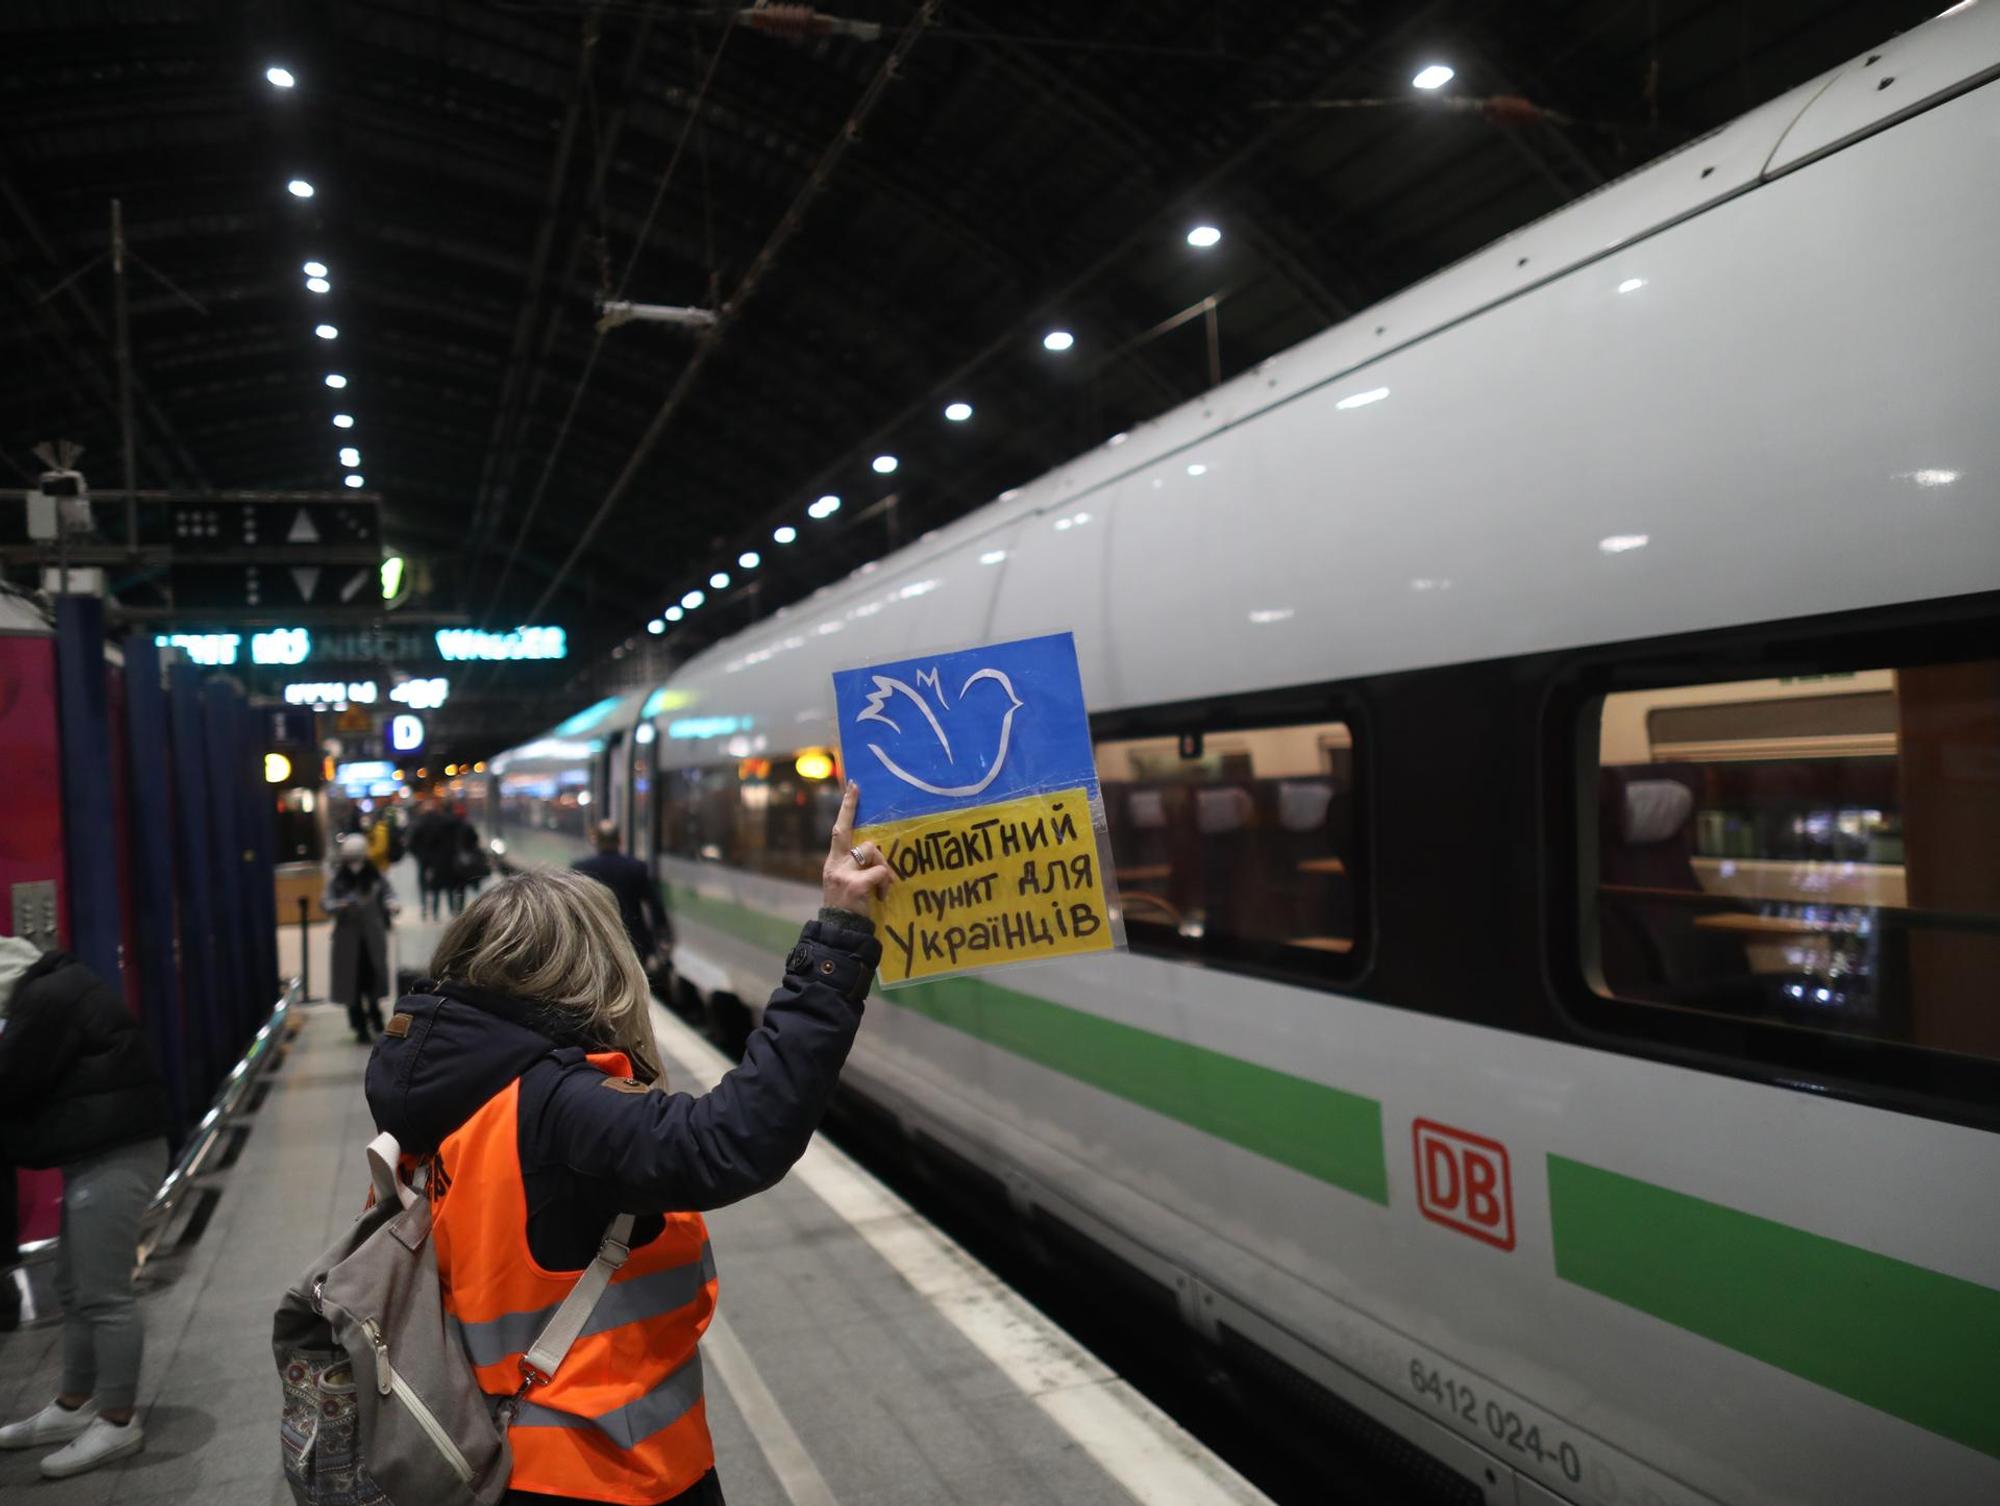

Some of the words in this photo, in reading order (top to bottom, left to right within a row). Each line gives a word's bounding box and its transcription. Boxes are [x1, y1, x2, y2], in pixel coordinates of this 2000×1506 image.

[912, 872, 999, 921] пункт
[1018, 853, 1093, 896] для
[1424, 1137, 1501, 1227] DB
[1409, 1358, 1479, 1426] 6412
[1486, 1400, 1581, 1483] 024-0
